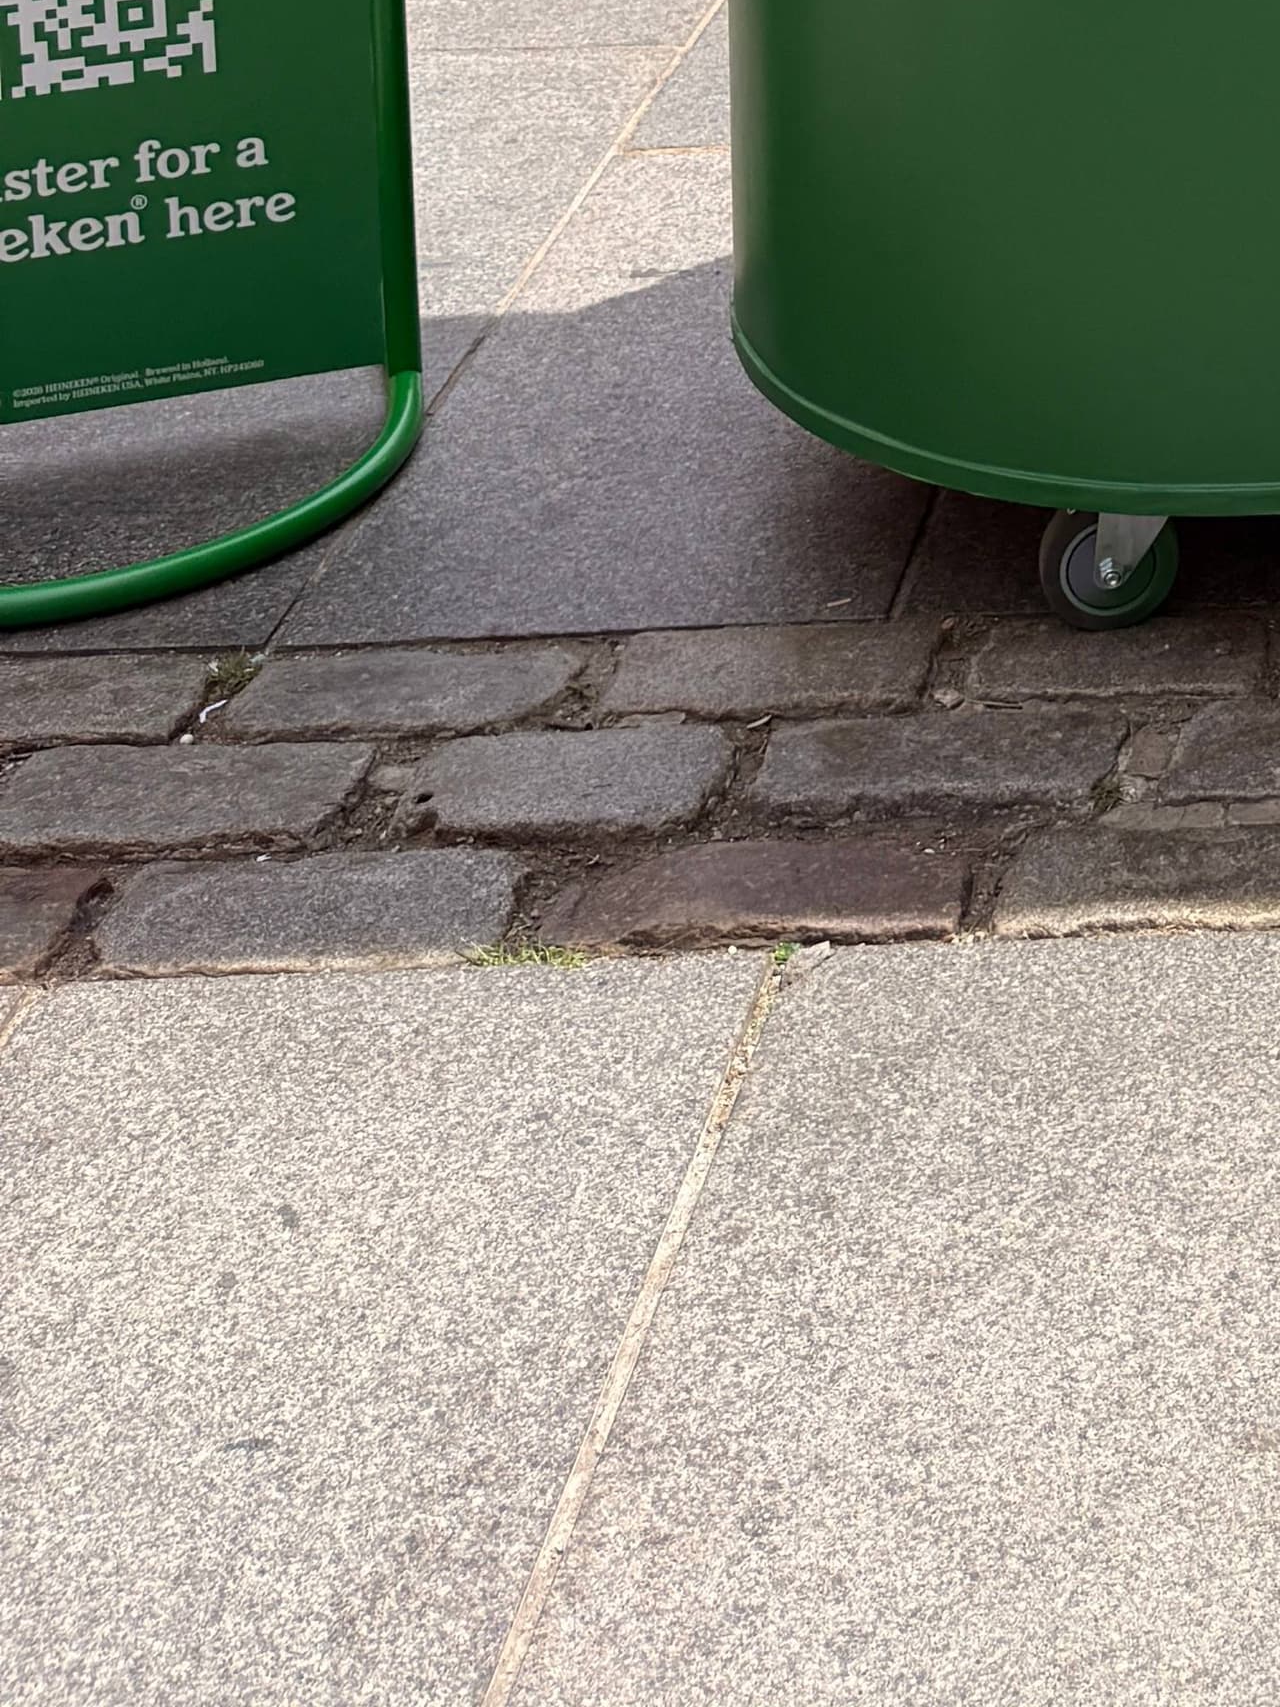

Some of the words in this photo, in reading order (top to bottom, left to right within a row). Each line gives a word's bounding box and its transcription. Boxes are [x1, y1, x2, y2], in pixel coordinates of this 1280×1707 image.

[0, 157, 120, 202] ster
[133, 139, 220, 183] for
[235, 136, 269, 168] a
[164, 192, 296, 238] here
[58, 392, 71, 402] by
